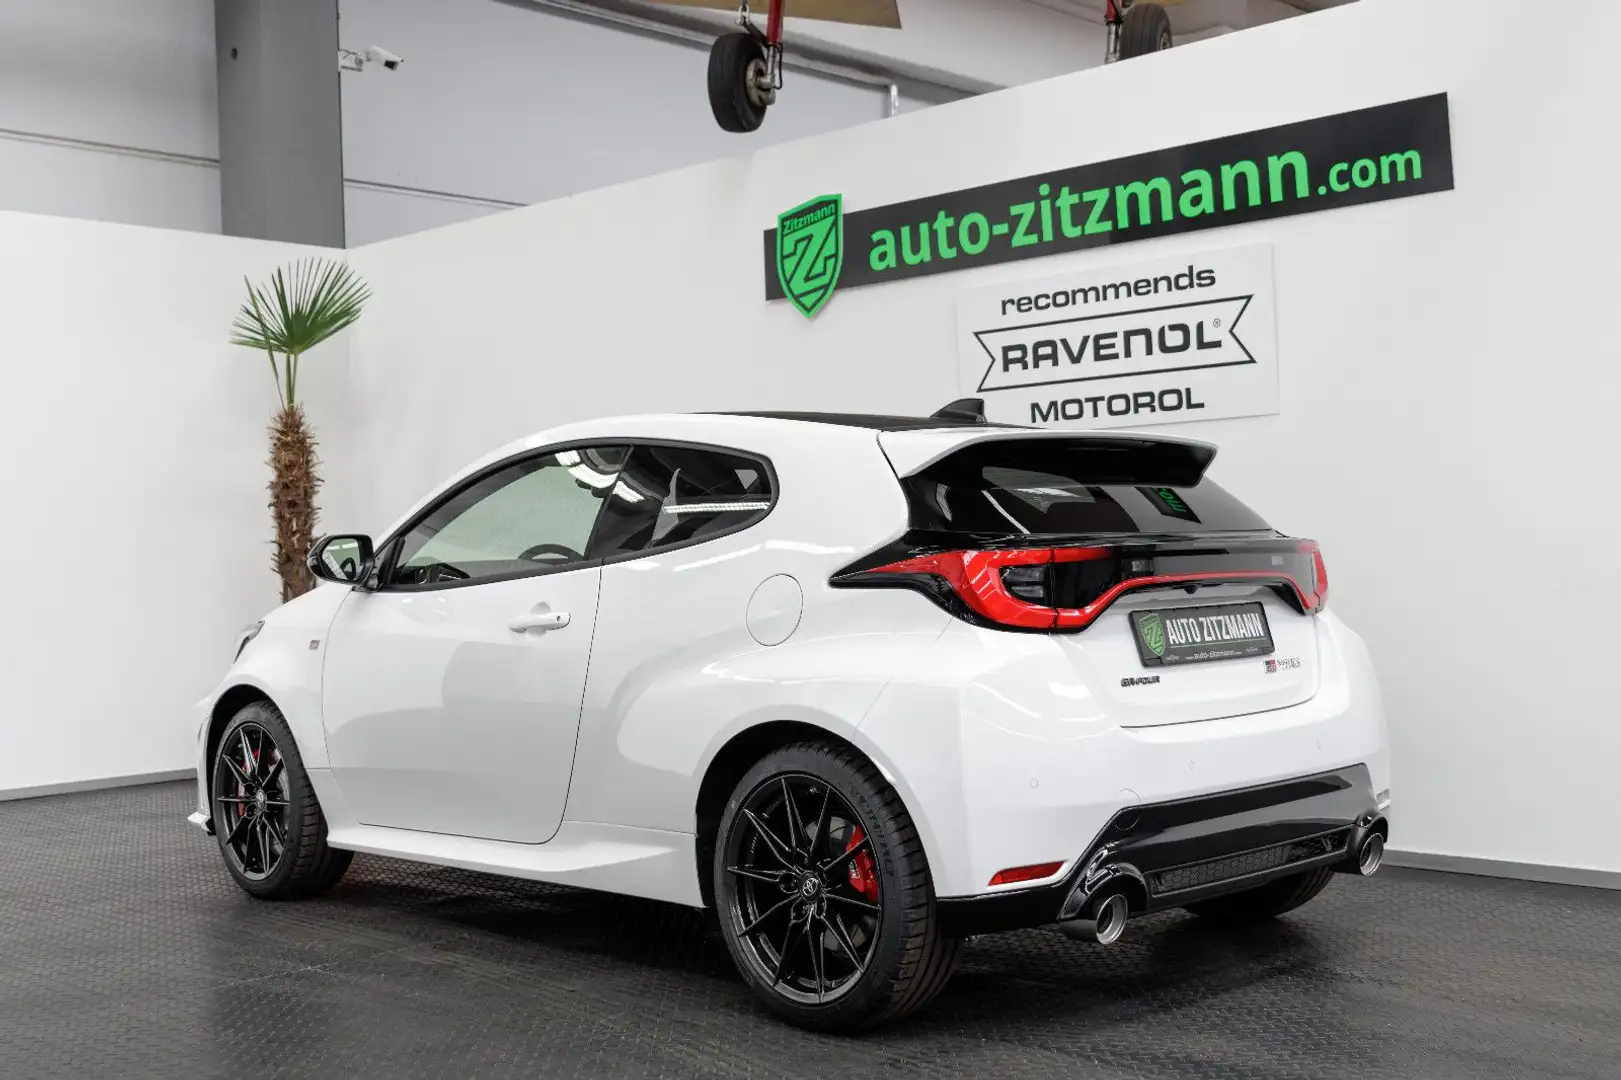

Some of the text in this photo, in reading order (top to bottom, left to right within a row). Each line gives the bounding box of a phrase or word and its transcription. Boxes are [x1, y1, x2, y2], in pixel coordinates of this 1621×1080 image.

[783, 203, 836, 234] Zitzmann
[868, 149, 1422, 272] auto-zitzmann.com
[1001, 265, 1216, 315] recommends
[1001, 320, 1222, 373] RAVENOL
[1030, 388, 1205, 424] MOTOROL
[1165, 613, 1264, 645] AUTO ZITZMANN
